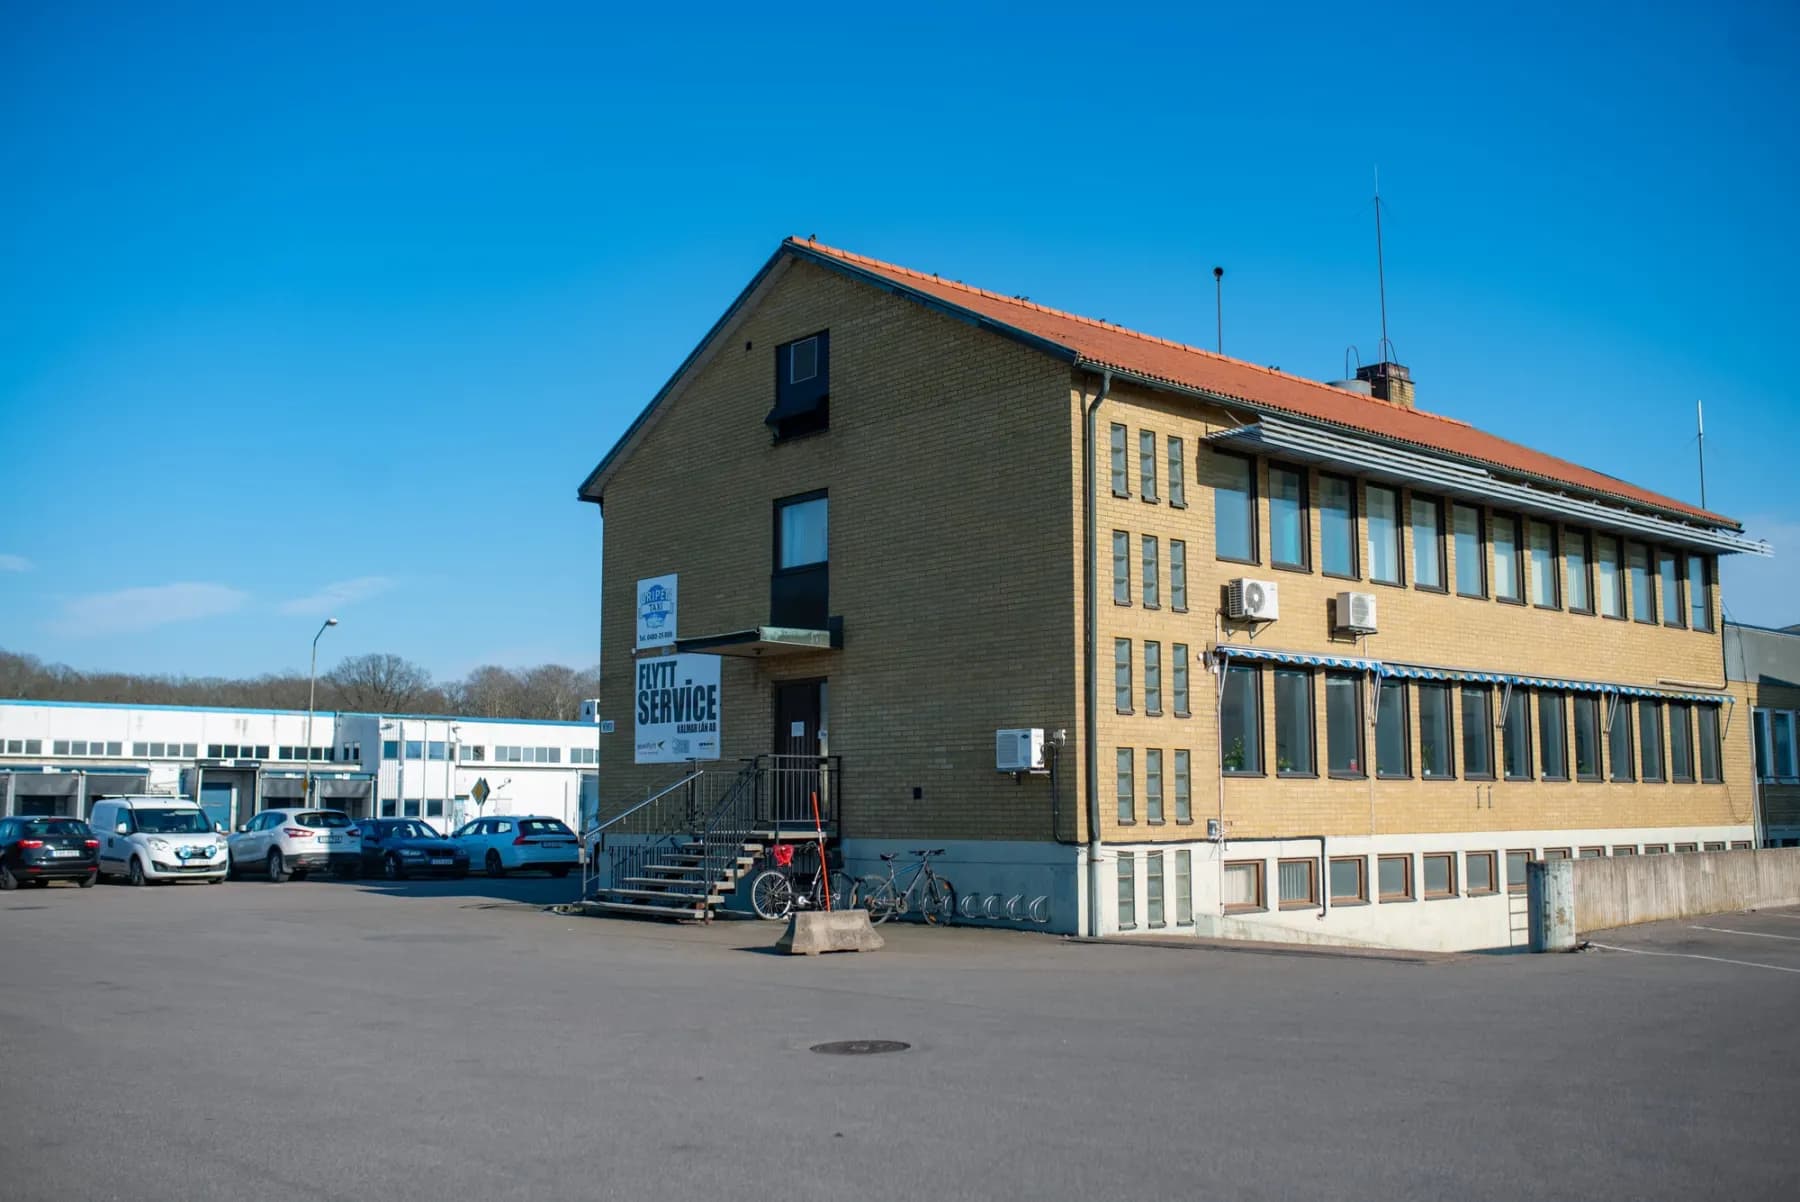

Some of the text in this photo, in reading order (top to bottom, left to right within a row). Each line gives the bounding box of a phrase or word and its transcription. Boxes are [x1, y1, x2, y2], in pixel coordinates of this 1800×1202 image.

[639, 661, 677, 690] FLYTT
[677, 723, 697, 734] KALMAR
[709, 722, 716, 732] AB
